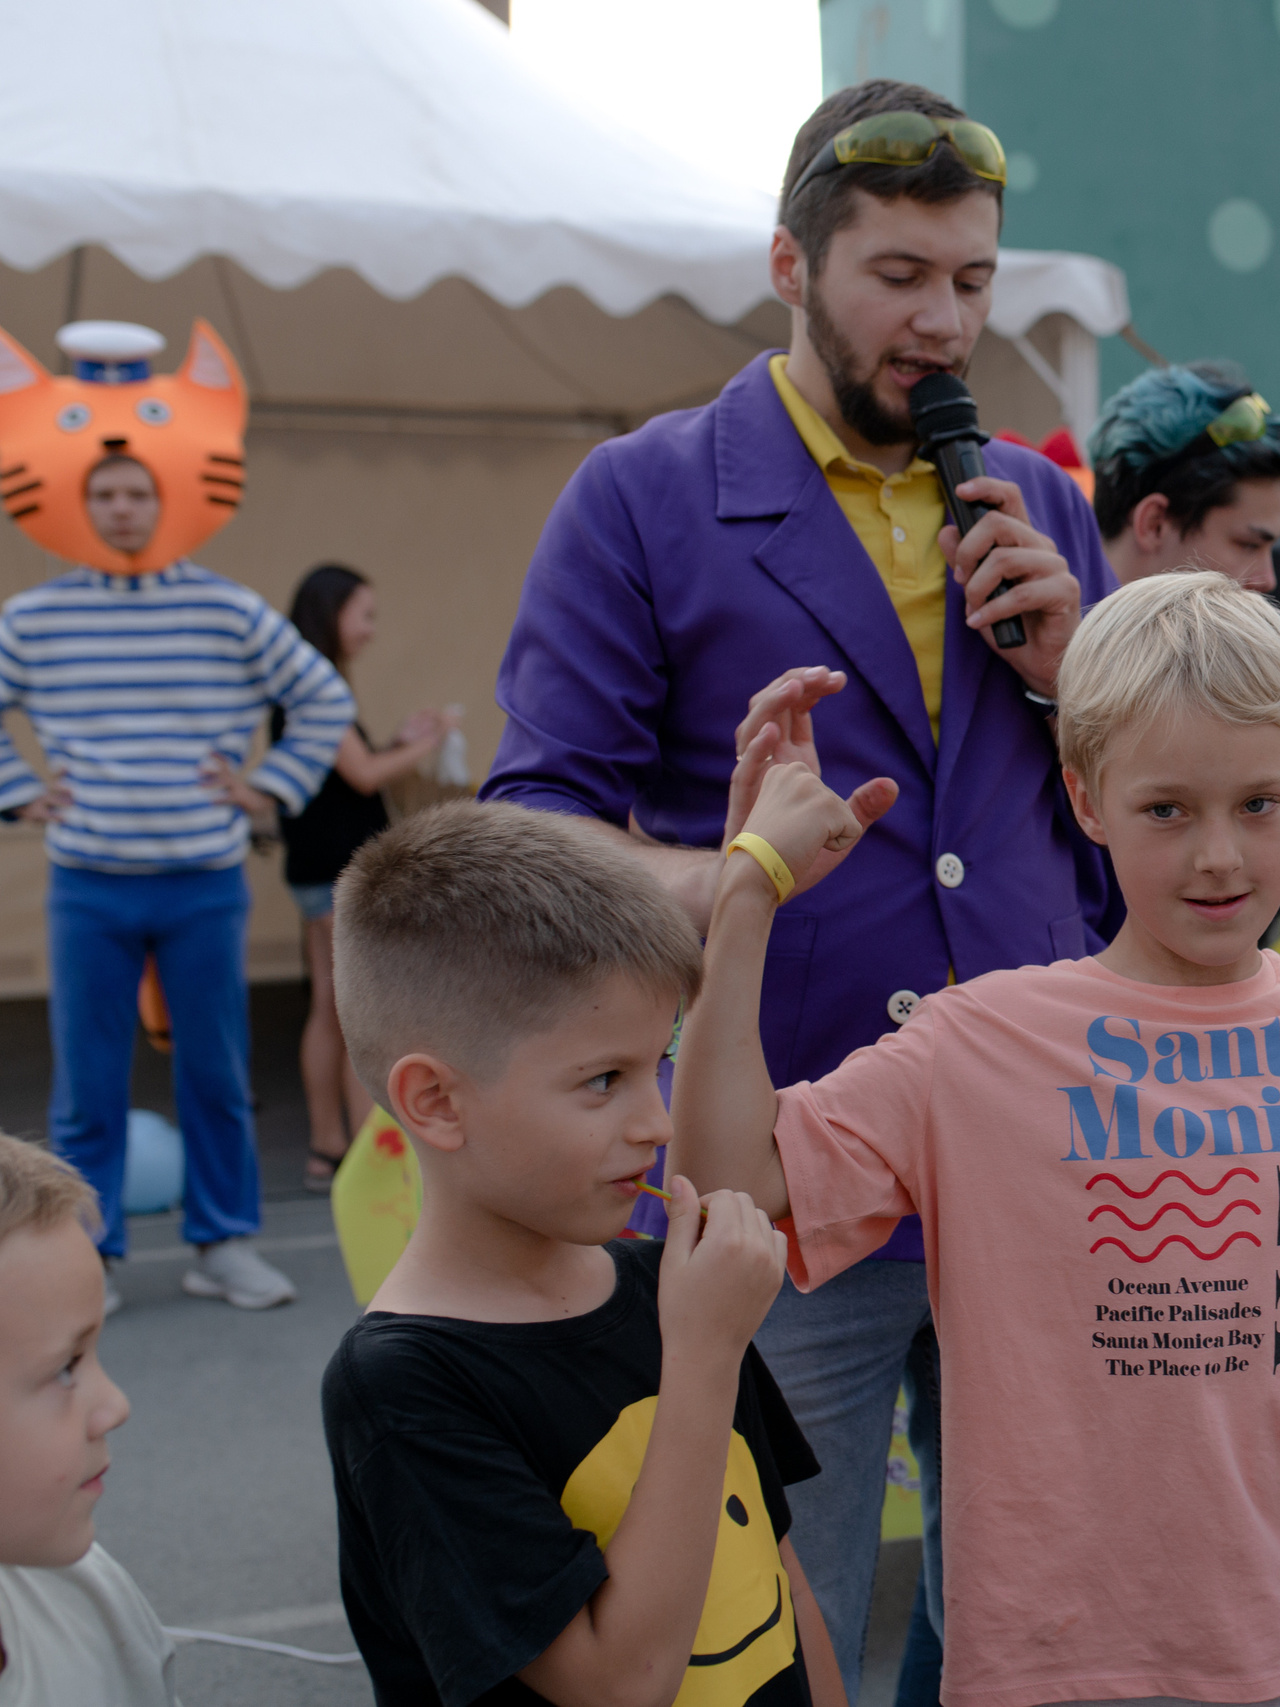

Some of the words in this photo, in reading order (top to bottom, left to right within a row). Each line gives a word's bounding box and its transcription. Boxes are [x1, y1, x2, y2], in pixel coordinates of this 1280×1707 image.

[1107, 1277, 1171, 1296] Ocean
[1174, 1276, 1249, 1295] Avenue
[1094, 1304, 1165, 1323] Pacific
[1168, 1301, 1262, 1322] Palisades
[1091, 1331, 1150, 1350] Santa
[1152, 1331, 1225, 1350] Monica
[1227, 1329, 1265, 1349] Bay
[1104, 1358, 1145, 1377] The
[1147, 1358, 1201, 1377] Place
[1204, 1362, 1222, 1376] to
[1224, 1355, 1250, 1373] Be
